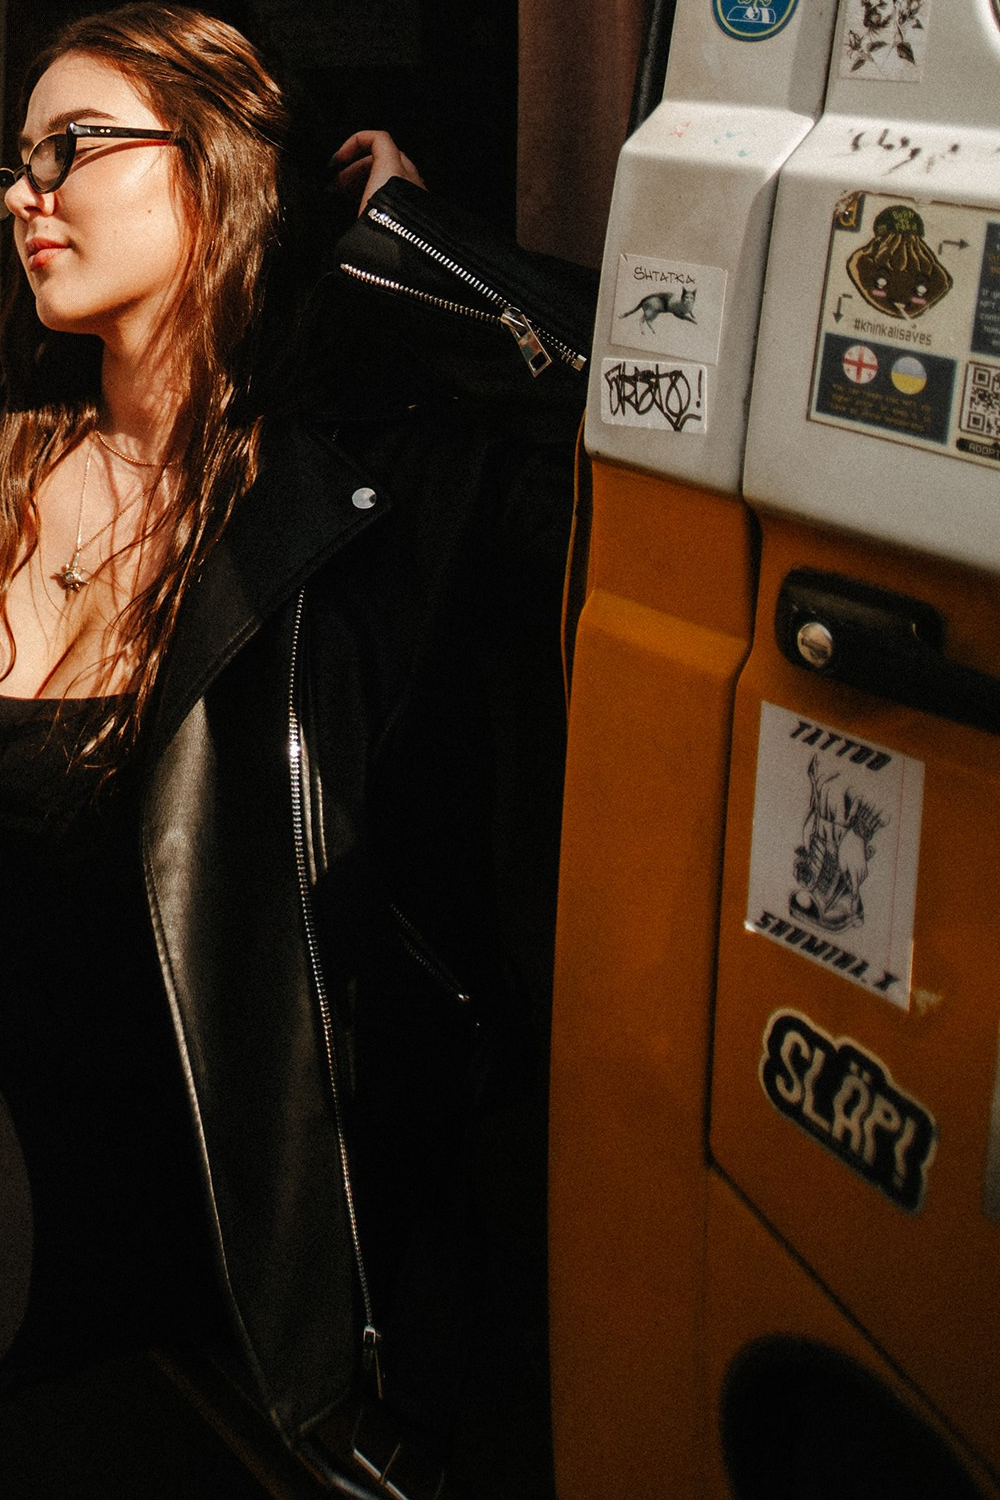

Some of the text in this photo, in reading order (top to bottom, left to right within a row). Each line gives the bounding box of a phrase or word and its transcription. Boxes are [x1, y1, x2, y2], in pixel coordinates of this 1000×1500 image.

[633, 266, 696, 284] SHTATKA
[854, 318, 932, 346] #khinkalisaves
[789, 720, 892, 772] TATTOO
